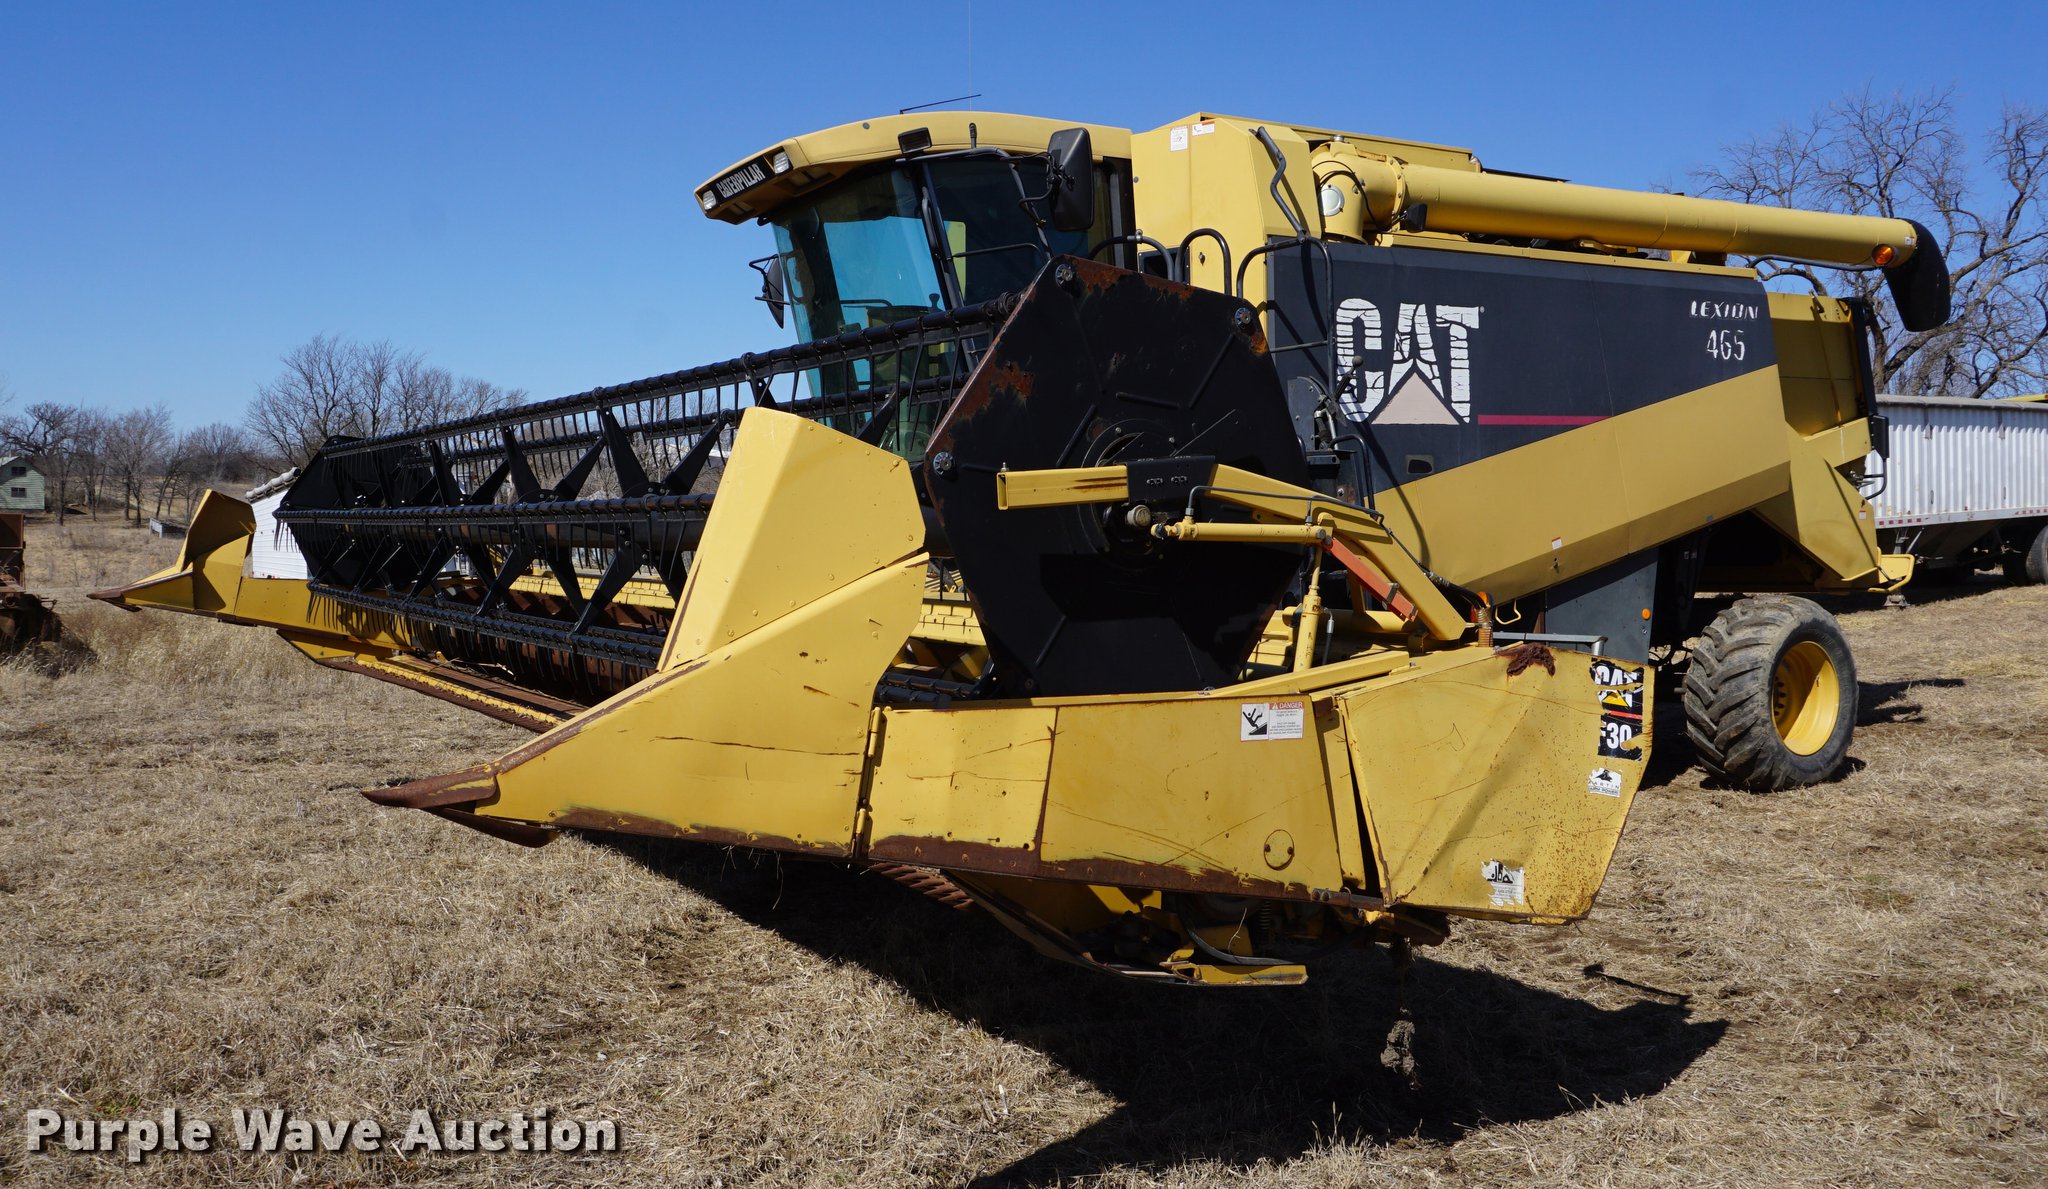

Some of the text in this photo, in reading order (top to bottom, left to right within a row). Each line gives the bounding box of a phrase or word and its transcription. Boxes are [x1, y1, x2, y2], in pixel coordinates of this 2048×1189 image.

[716, 163, 766, 199] CATERPILLAR
[1691, 300, 1758, 319] LEXION
[1336, 298, 1479, 424] CAT
[1707, 329, 1745, 361] 465
[1279, 701, 1303, 710] DANGER
